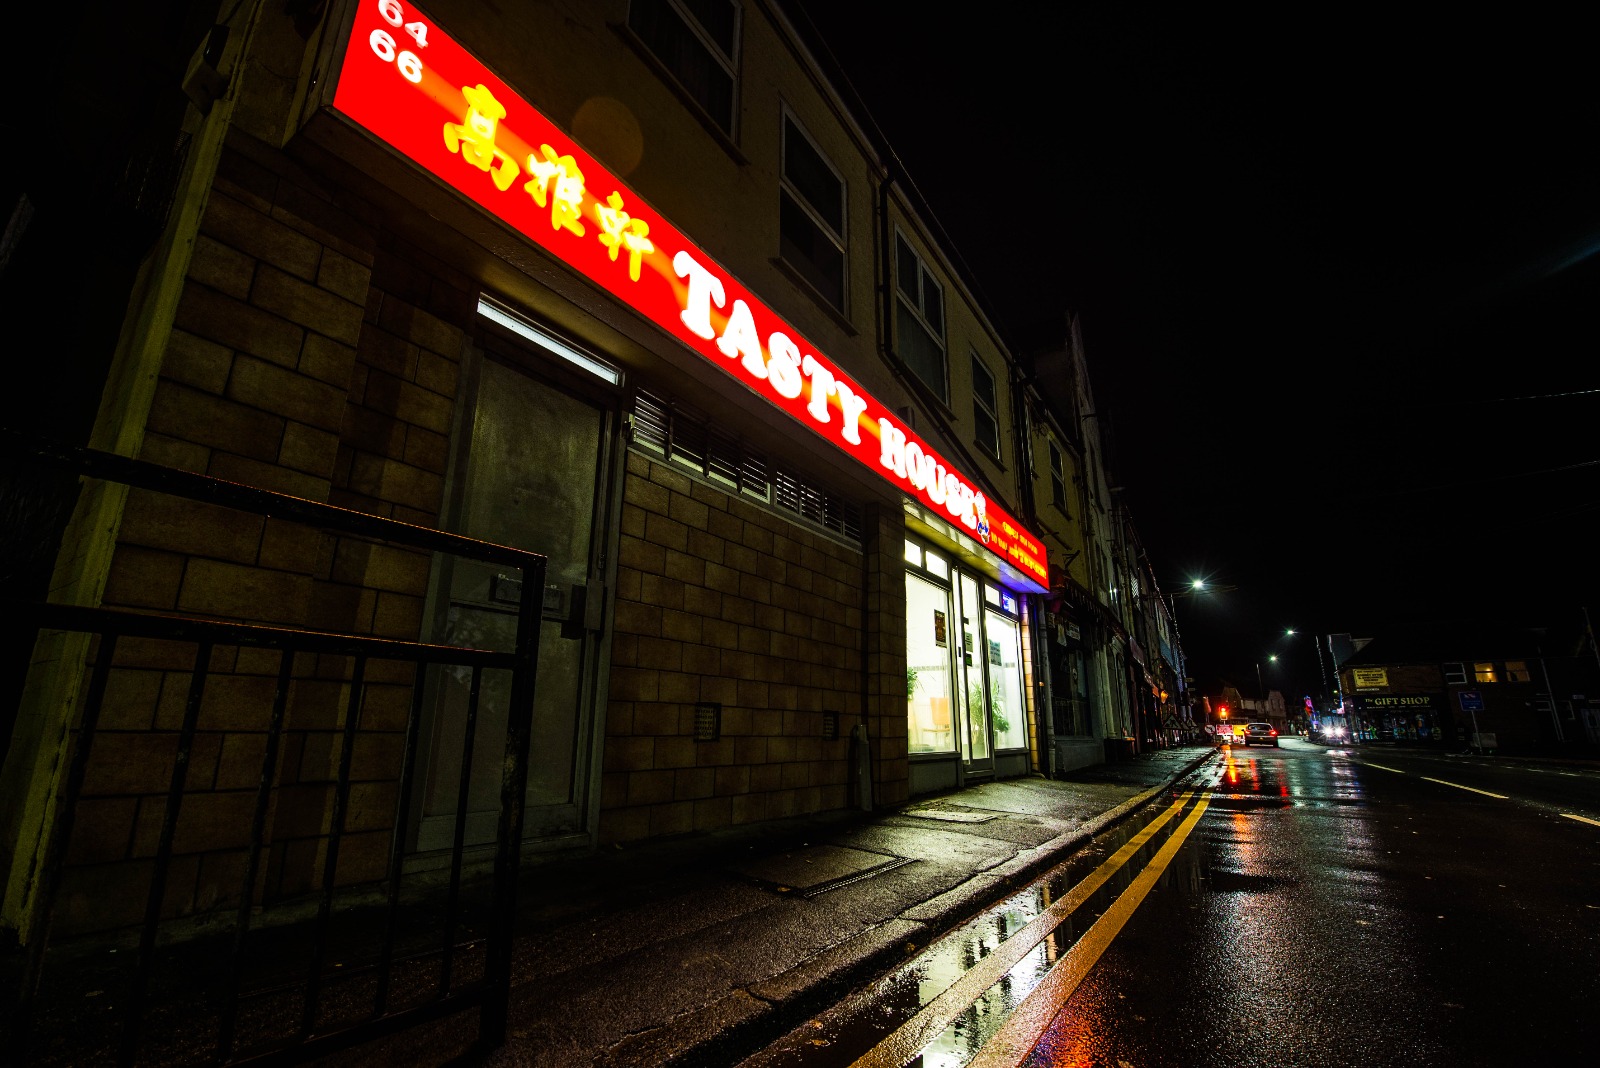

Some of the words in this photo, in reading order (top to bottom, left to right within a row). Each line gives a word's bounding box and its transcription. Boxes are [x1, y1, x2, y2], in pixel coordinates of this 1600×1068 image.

[377, 0, 428, 49] 64
[369, 29, 424, 84] 66
[672, 250, 868, 446] TASTY
[878, 417, 978, 531] HOUSE
[1374, 697, 1399, 706] GIFT
[1400, 696, 1430, 705] SHOP
